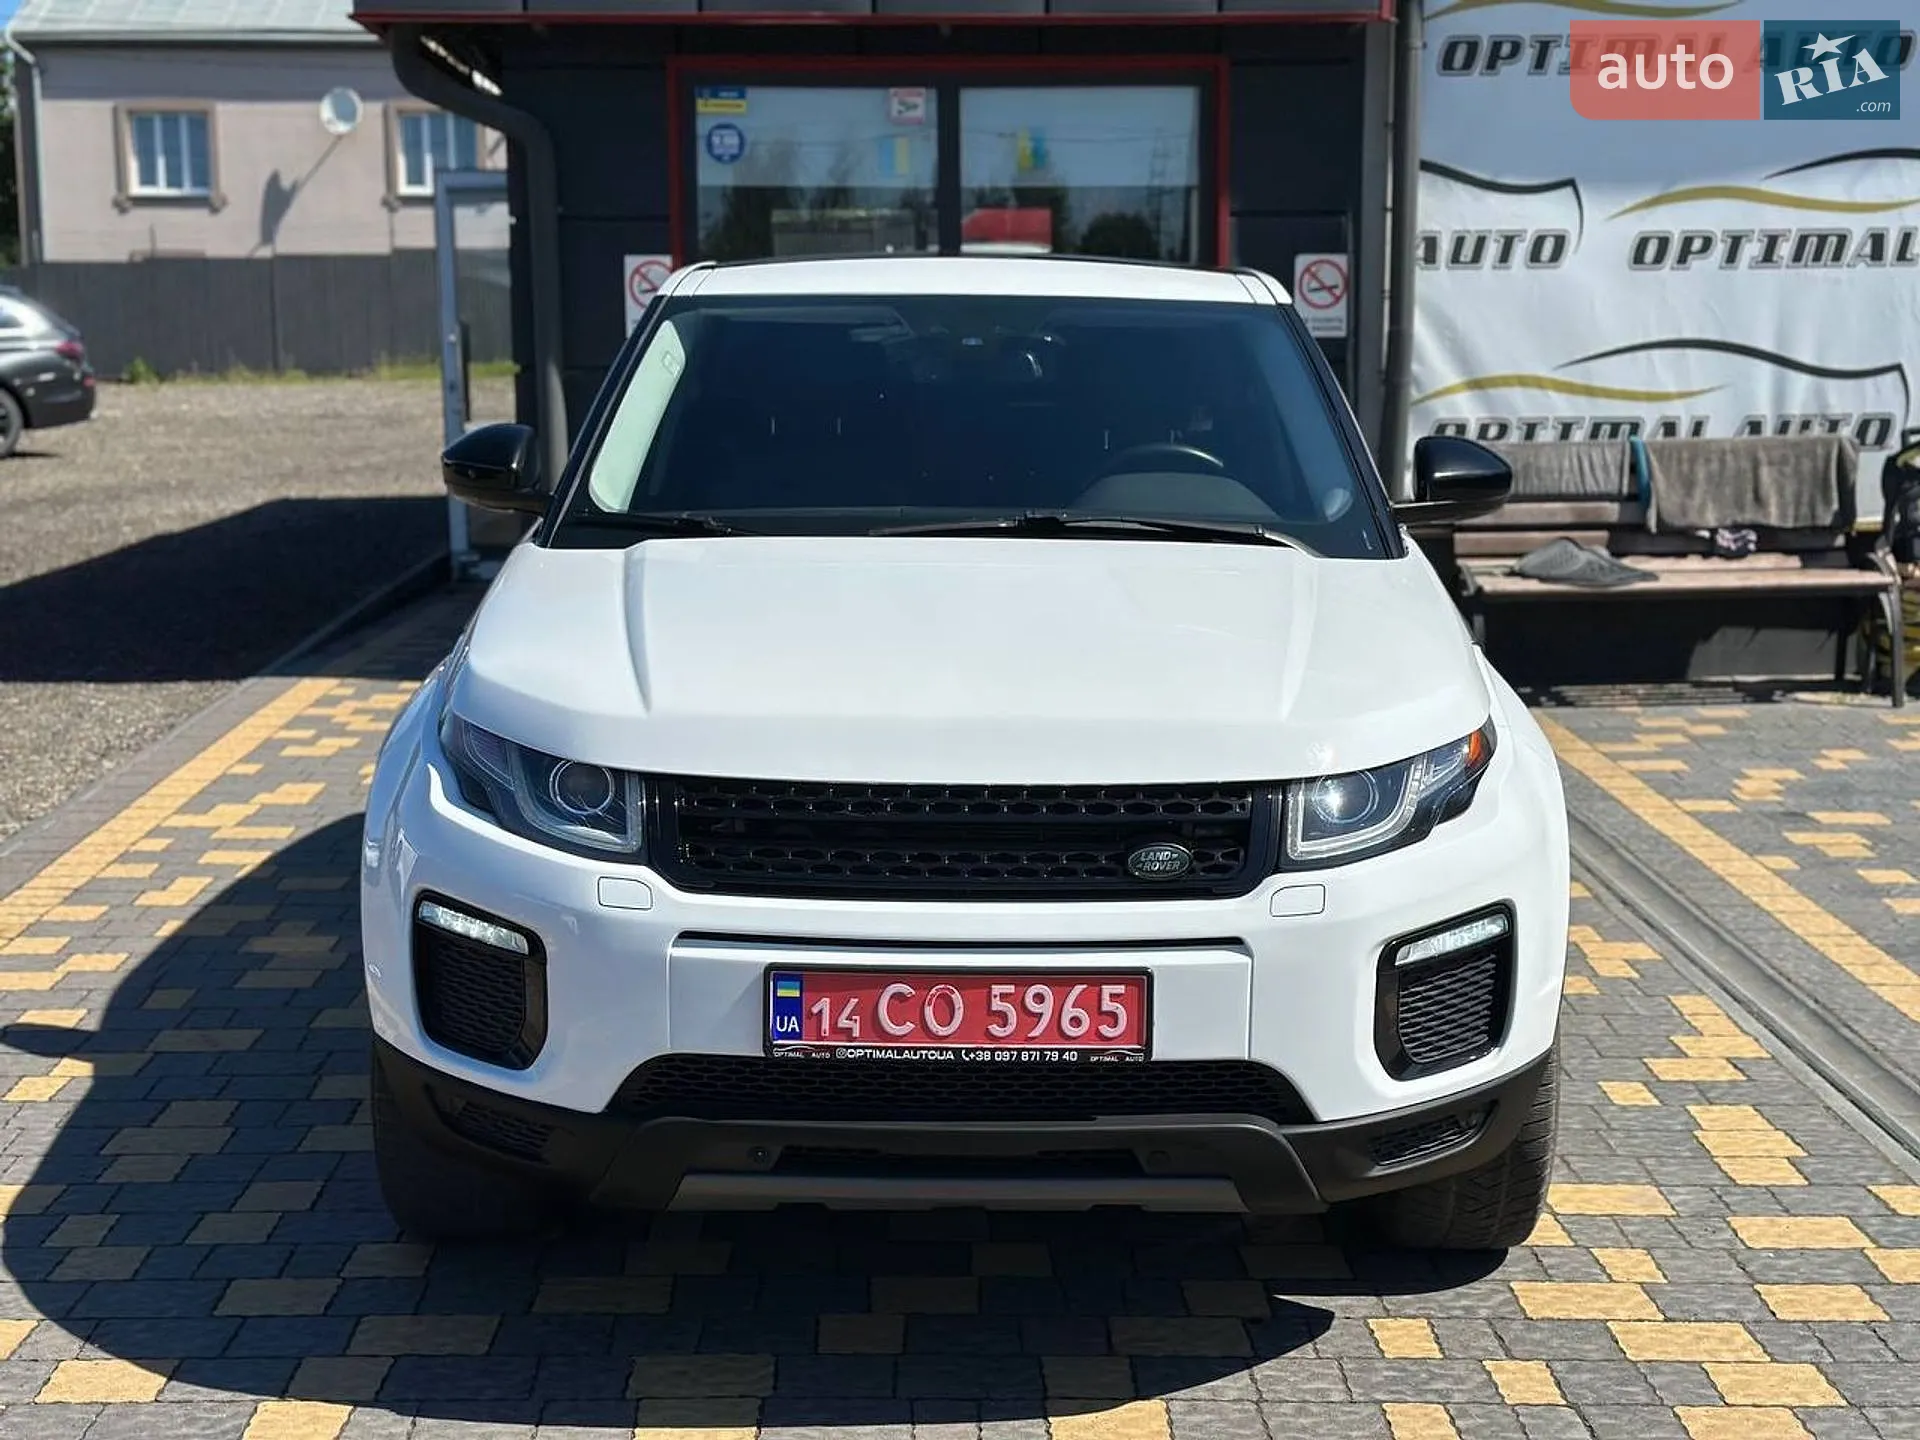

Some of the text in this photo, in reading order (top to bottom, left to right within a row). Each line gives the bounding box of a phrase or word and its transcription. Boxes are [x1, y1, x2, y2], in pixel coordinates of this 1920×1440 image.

[1416, 228, 1572, 270] AUTO
[1628, 226, 1920, 271] OPTIMAL
[1141, 851, 1171, 861] LAND
[1143, 861, 1180, 871] ROVER
[811, 983, 1128, 1040] 14 CO 5965
[776, 1016, 800, 1033] UA
[995, 1051, 1016, 1061] 097
[1021, 1051, 1040, 1062] 871
[1044, 1051, 1059, 1062] 79
[1062, 1051, 1079, 1062] 40
